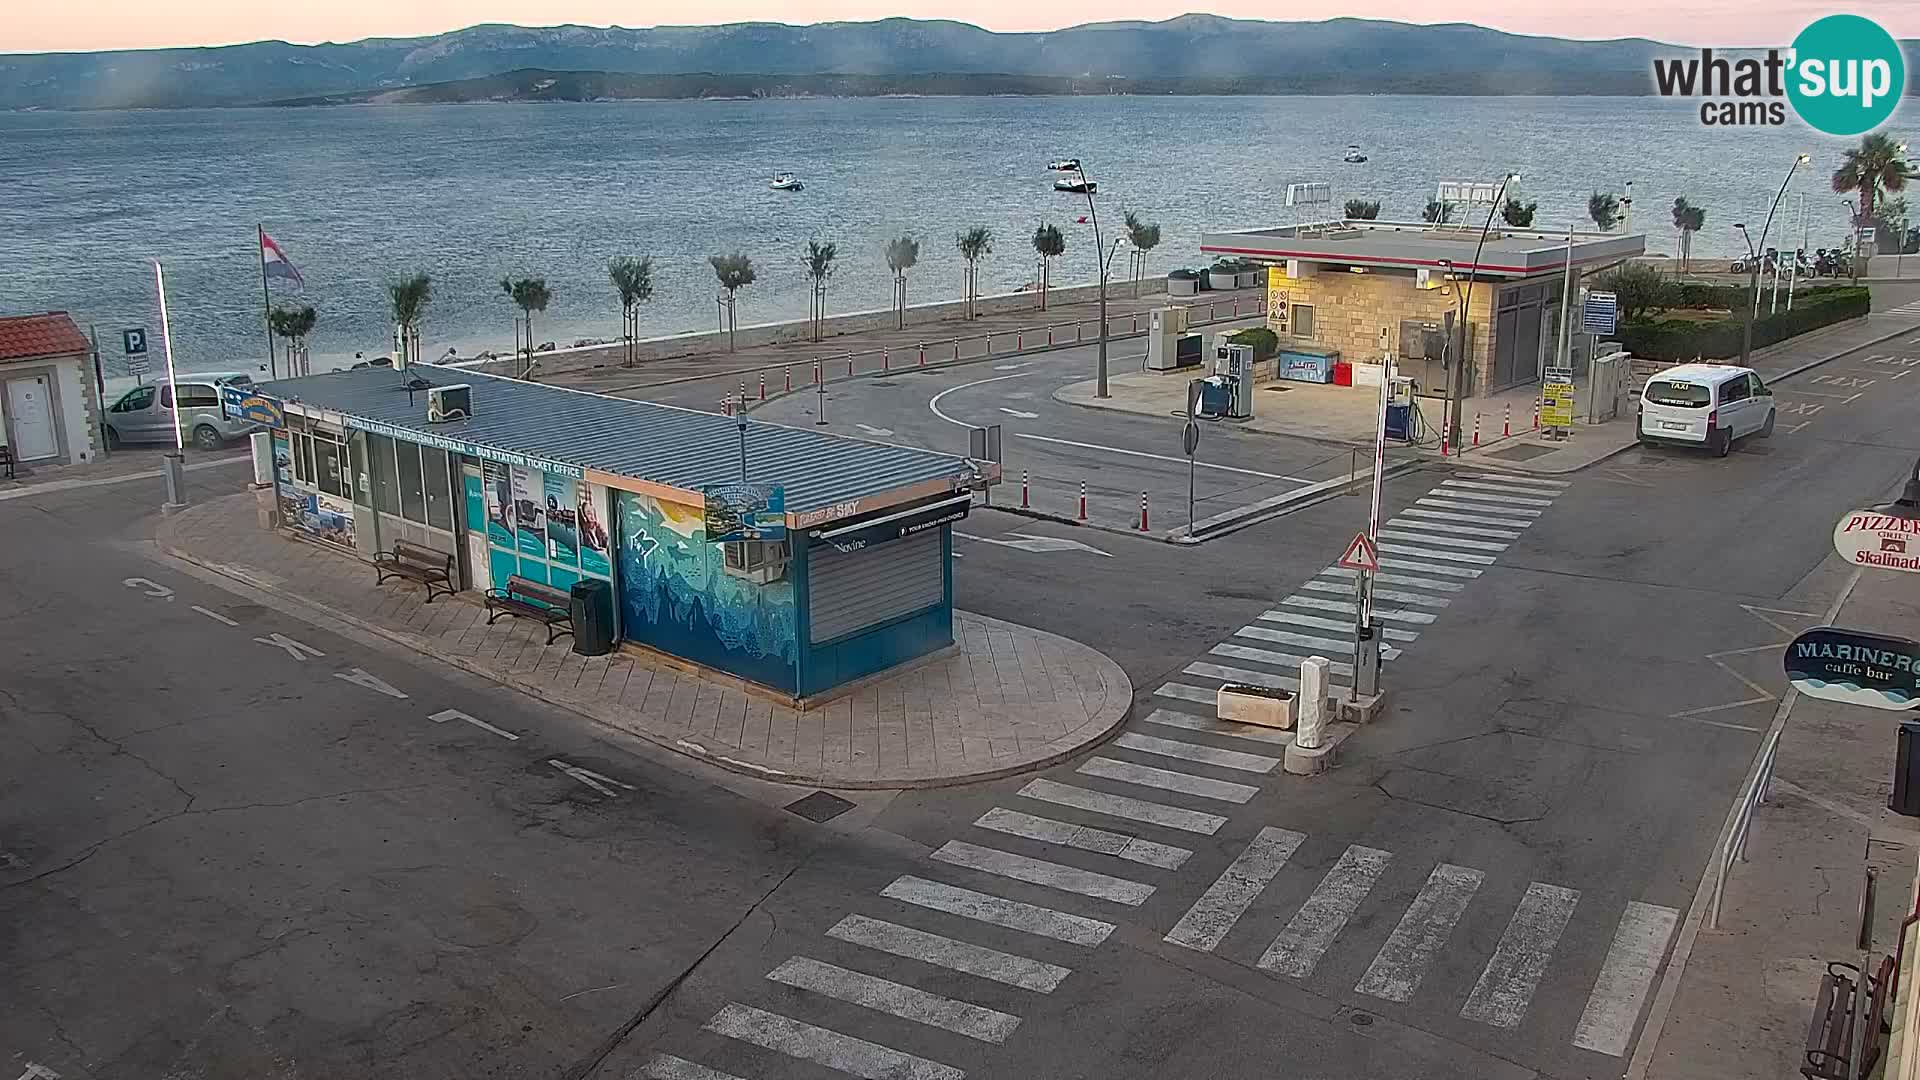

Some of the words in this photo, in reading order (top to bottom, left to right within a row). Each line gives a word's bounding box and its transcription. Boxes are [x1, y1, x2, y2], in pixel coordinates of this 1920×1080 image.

[128, 332, 141, 351] P
[1671, 382, 1689, 391] TAXI
[394, 428, 433, 445] AUTOBUSNA
[435, 437, 466, 452] POSTAJA
[476, 447, 491, 458] BUS
[492, 450, 524, 466] STATION
[526, 458, 552, 472] TICKET
[555, 464, 580, 478] OFFICE
[834, 539, 867, 554] Novine
[1855, 550, 1920, 570] Skalinad
[1825, 661, 1862, 676] caffe
[1866, 665, 1893, 681] bar
